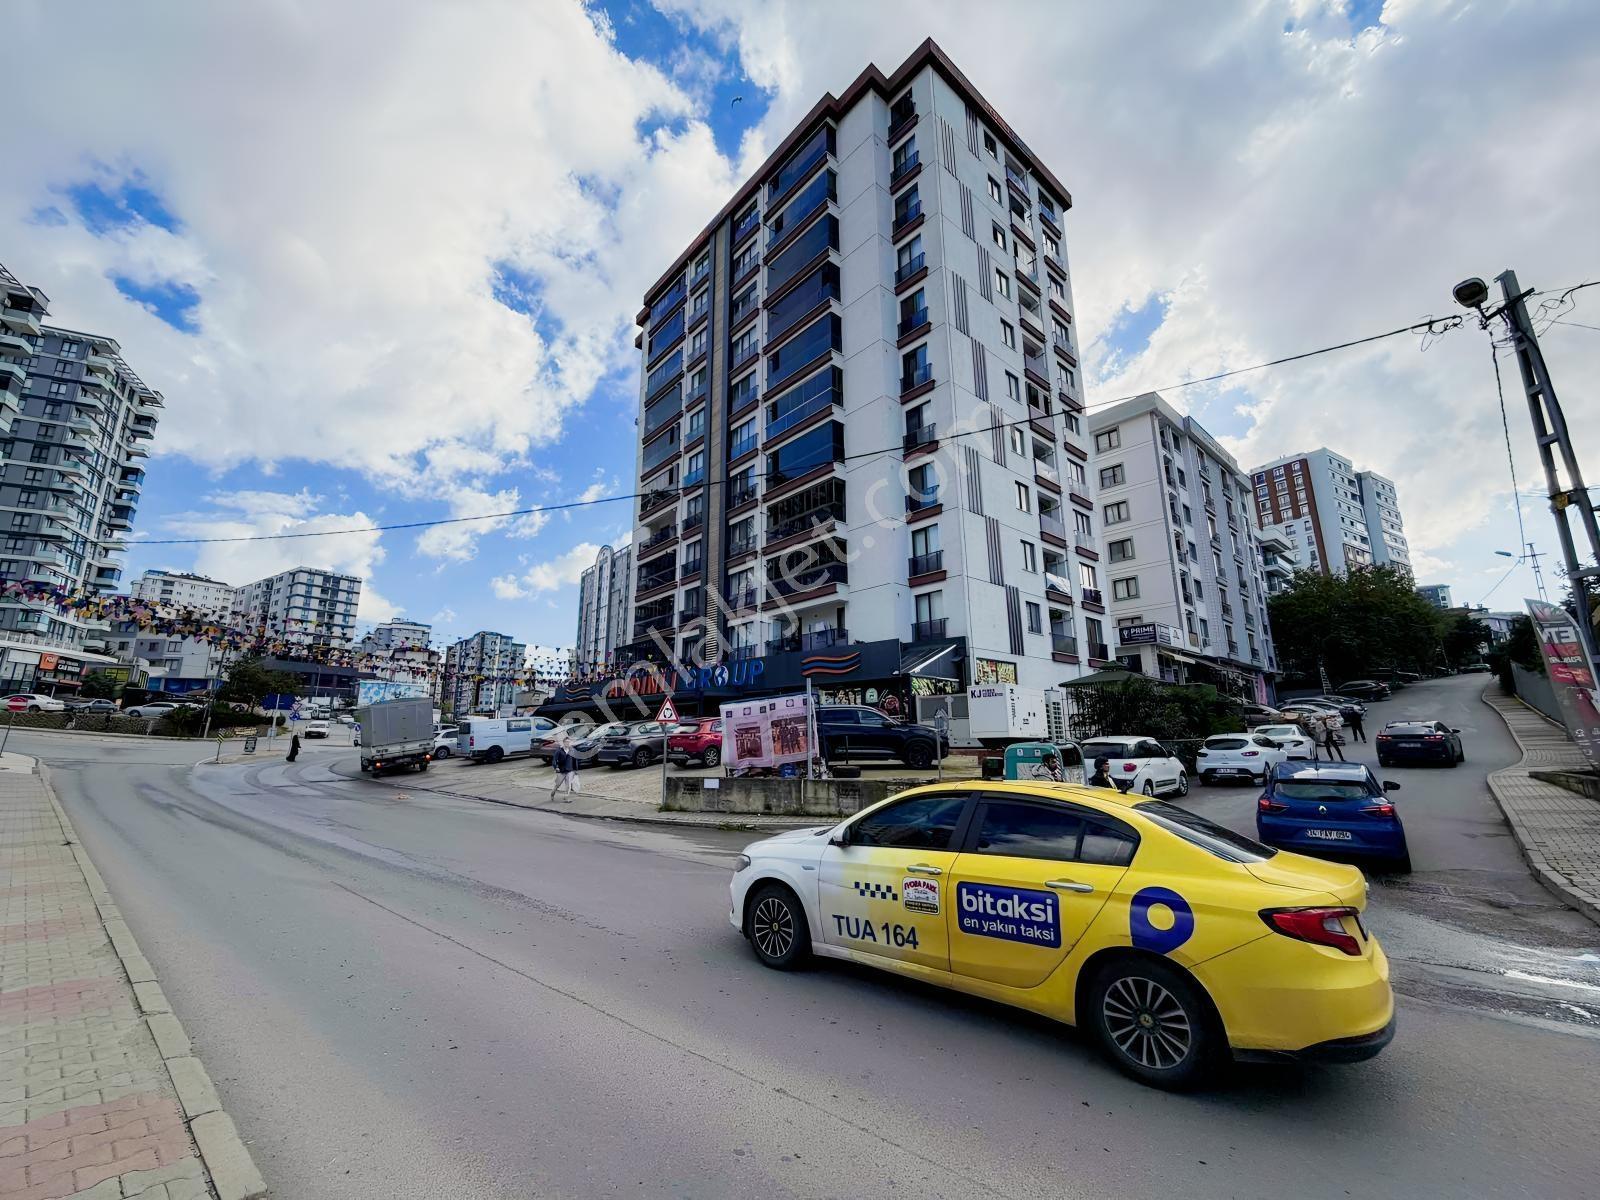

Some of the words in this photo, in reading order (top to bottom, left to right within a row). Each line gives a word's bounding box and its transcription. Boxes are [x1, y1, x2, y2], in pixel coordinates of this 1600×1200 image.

[1130, 625, 1154, 634] PRIME
[970, 689, 982, 698] KJ
[961, 888, 1054, 924] bitaksi
[832, 914, 877, 943] TUA
[881, 922, 919, 950] 164
[963, 917, 979, 929] en
[981, 919, 1017, 935] yakın
[1020, 923, 1055, 941] taksi
